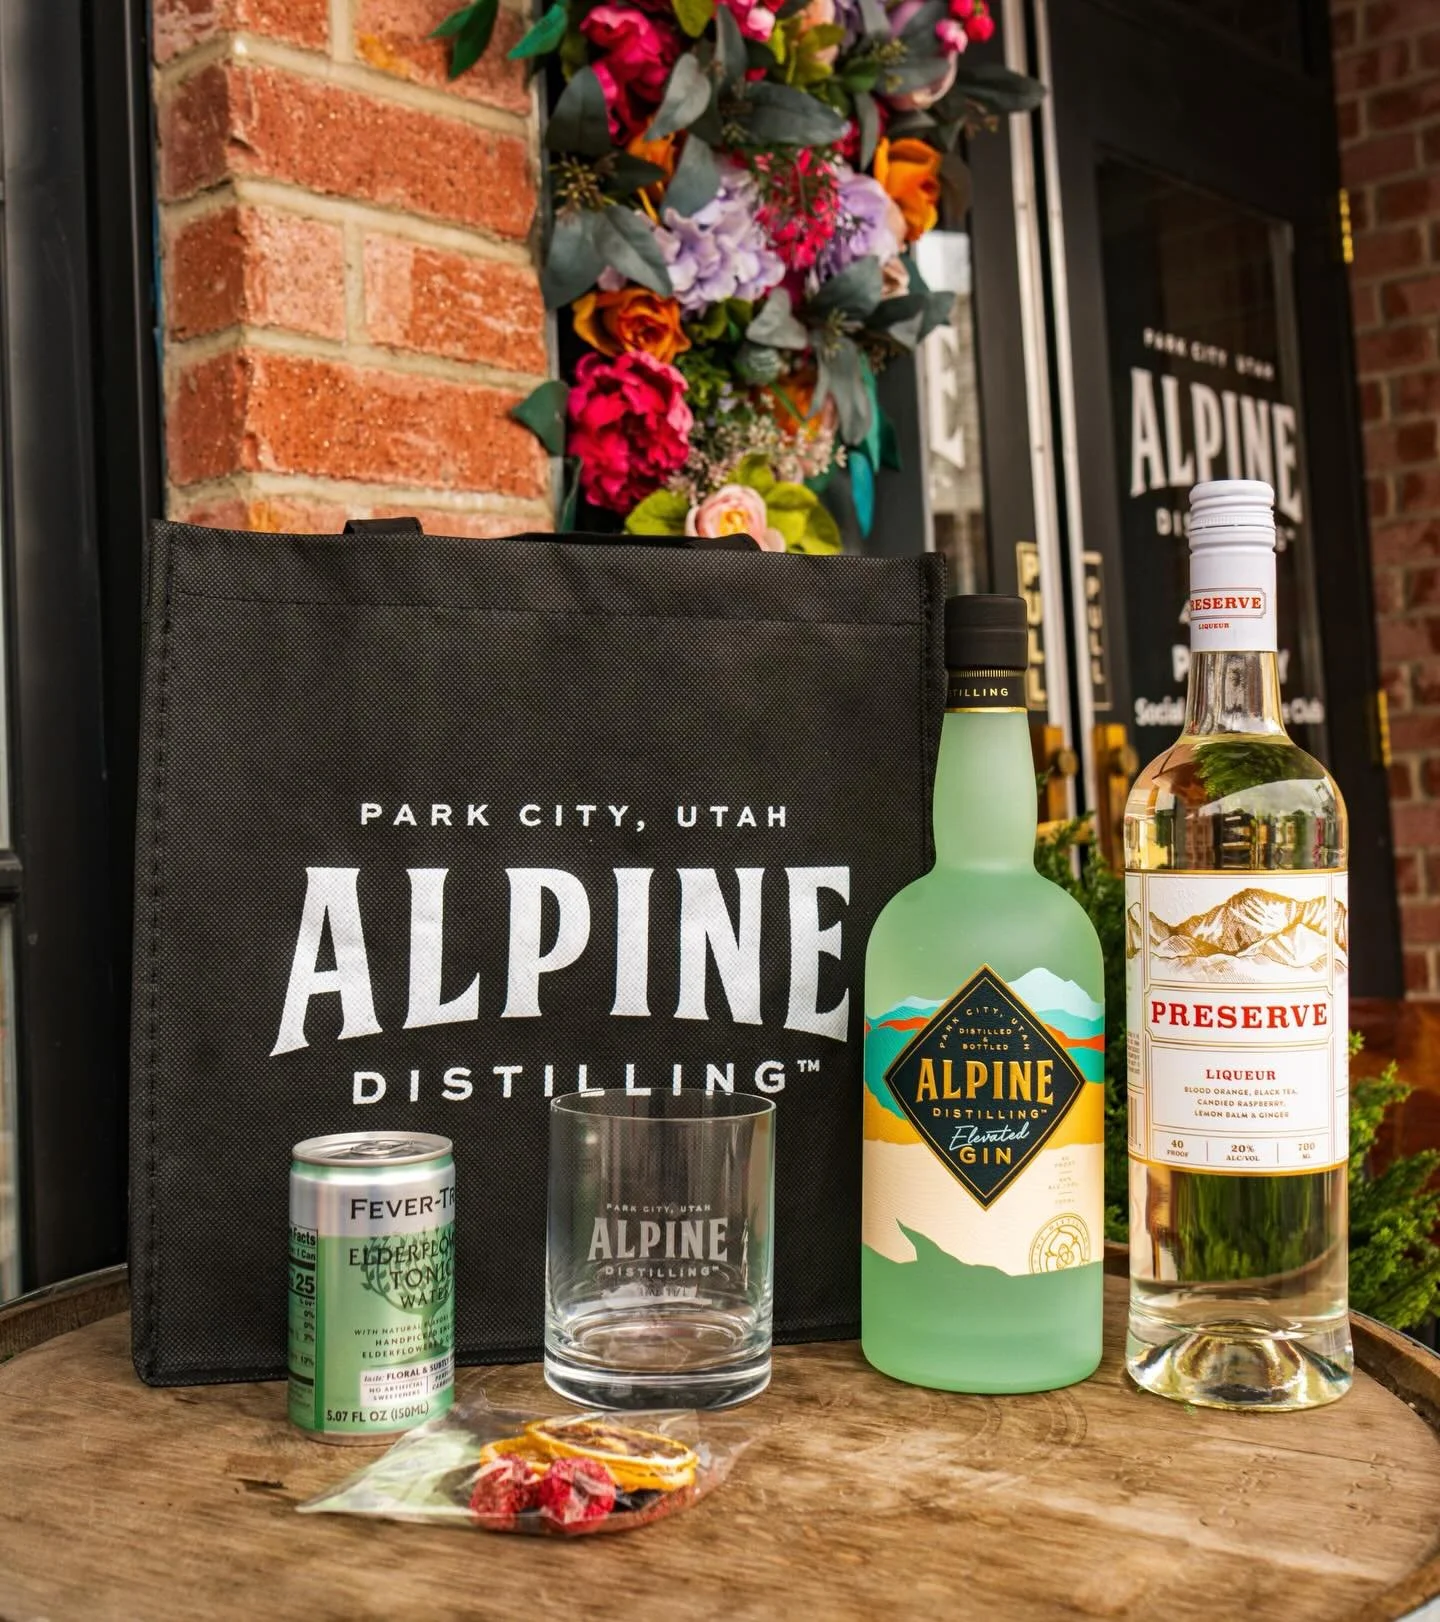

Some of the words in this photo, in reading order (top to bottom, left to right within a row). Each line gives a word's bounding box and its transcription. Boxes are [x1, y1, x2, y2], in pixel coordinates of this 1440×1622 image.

[1129, 366, 1303, 525] ALPINE
[1198, 622, 1231, 630] LIQUEUR
[951, 687, 1009, 697] TILLING
[1135, 696, 1185, 726] Social
[360, 803, 490, 827] PARK
[519, 804, 645, 831] CITY,
[677, 805, 788, 828] UTAH
[269, 866, 851, 1057] ALPINE
[1151, 1000, 1328, 1029] PRESERVE
[940, 1017, 960, 1049] PARK
[966, 1006, 1004, 1017] CITY,
[1011, 1018, 1031, 1050] UTAH
[915, 1057, 1055, 1106] ALPINE
[1205, 1069, 1277, 1081] LIQUEUR
[1184, 1086, 1211, 1094] BLOOD
[1197, 1098, 1235, 1107] CANDIED
[1194, 1110, 1223, 1118] LEMON
[1225, 1111, 1248, 1119] BALM
[1258, 1111, 1290, 1119] GINGER
[949, 1121, 1031, 1151] Elevated
[959, 1146, 1012, 1165] GIN
[1166, 1149, 1189, 1158] PROOF
[1171, 1139, 1184, 1149] 40
[1231, 1144, 1255, 1153] 20%
[350, 1187, 455, 1220] FEVER-TR
[606, 1203, 637, 1213] PARK
[643, 1205, 675, 1214] CITY,
[680, 1203, 712, 1213] UTAH
[293, 1227, 316, 1246] Facts
[587, 1216, 729, 1262] ALPINE
[302, 1249, 316, 1261] Can
[350, 1236, 455, 1266] ELDERFLO
[296, 1272, 315, 1295] 25
[354, 1328, 378, 1336] WITH
[382, 1324, 421, 1335] NATURAL
[387, 1368, 420, 1380] FLORAL
[327, 1408, 348, 1422] 5.07
[352, 1410, 366, 1423] FL
[370, 1410, 387, 1421] OZ
